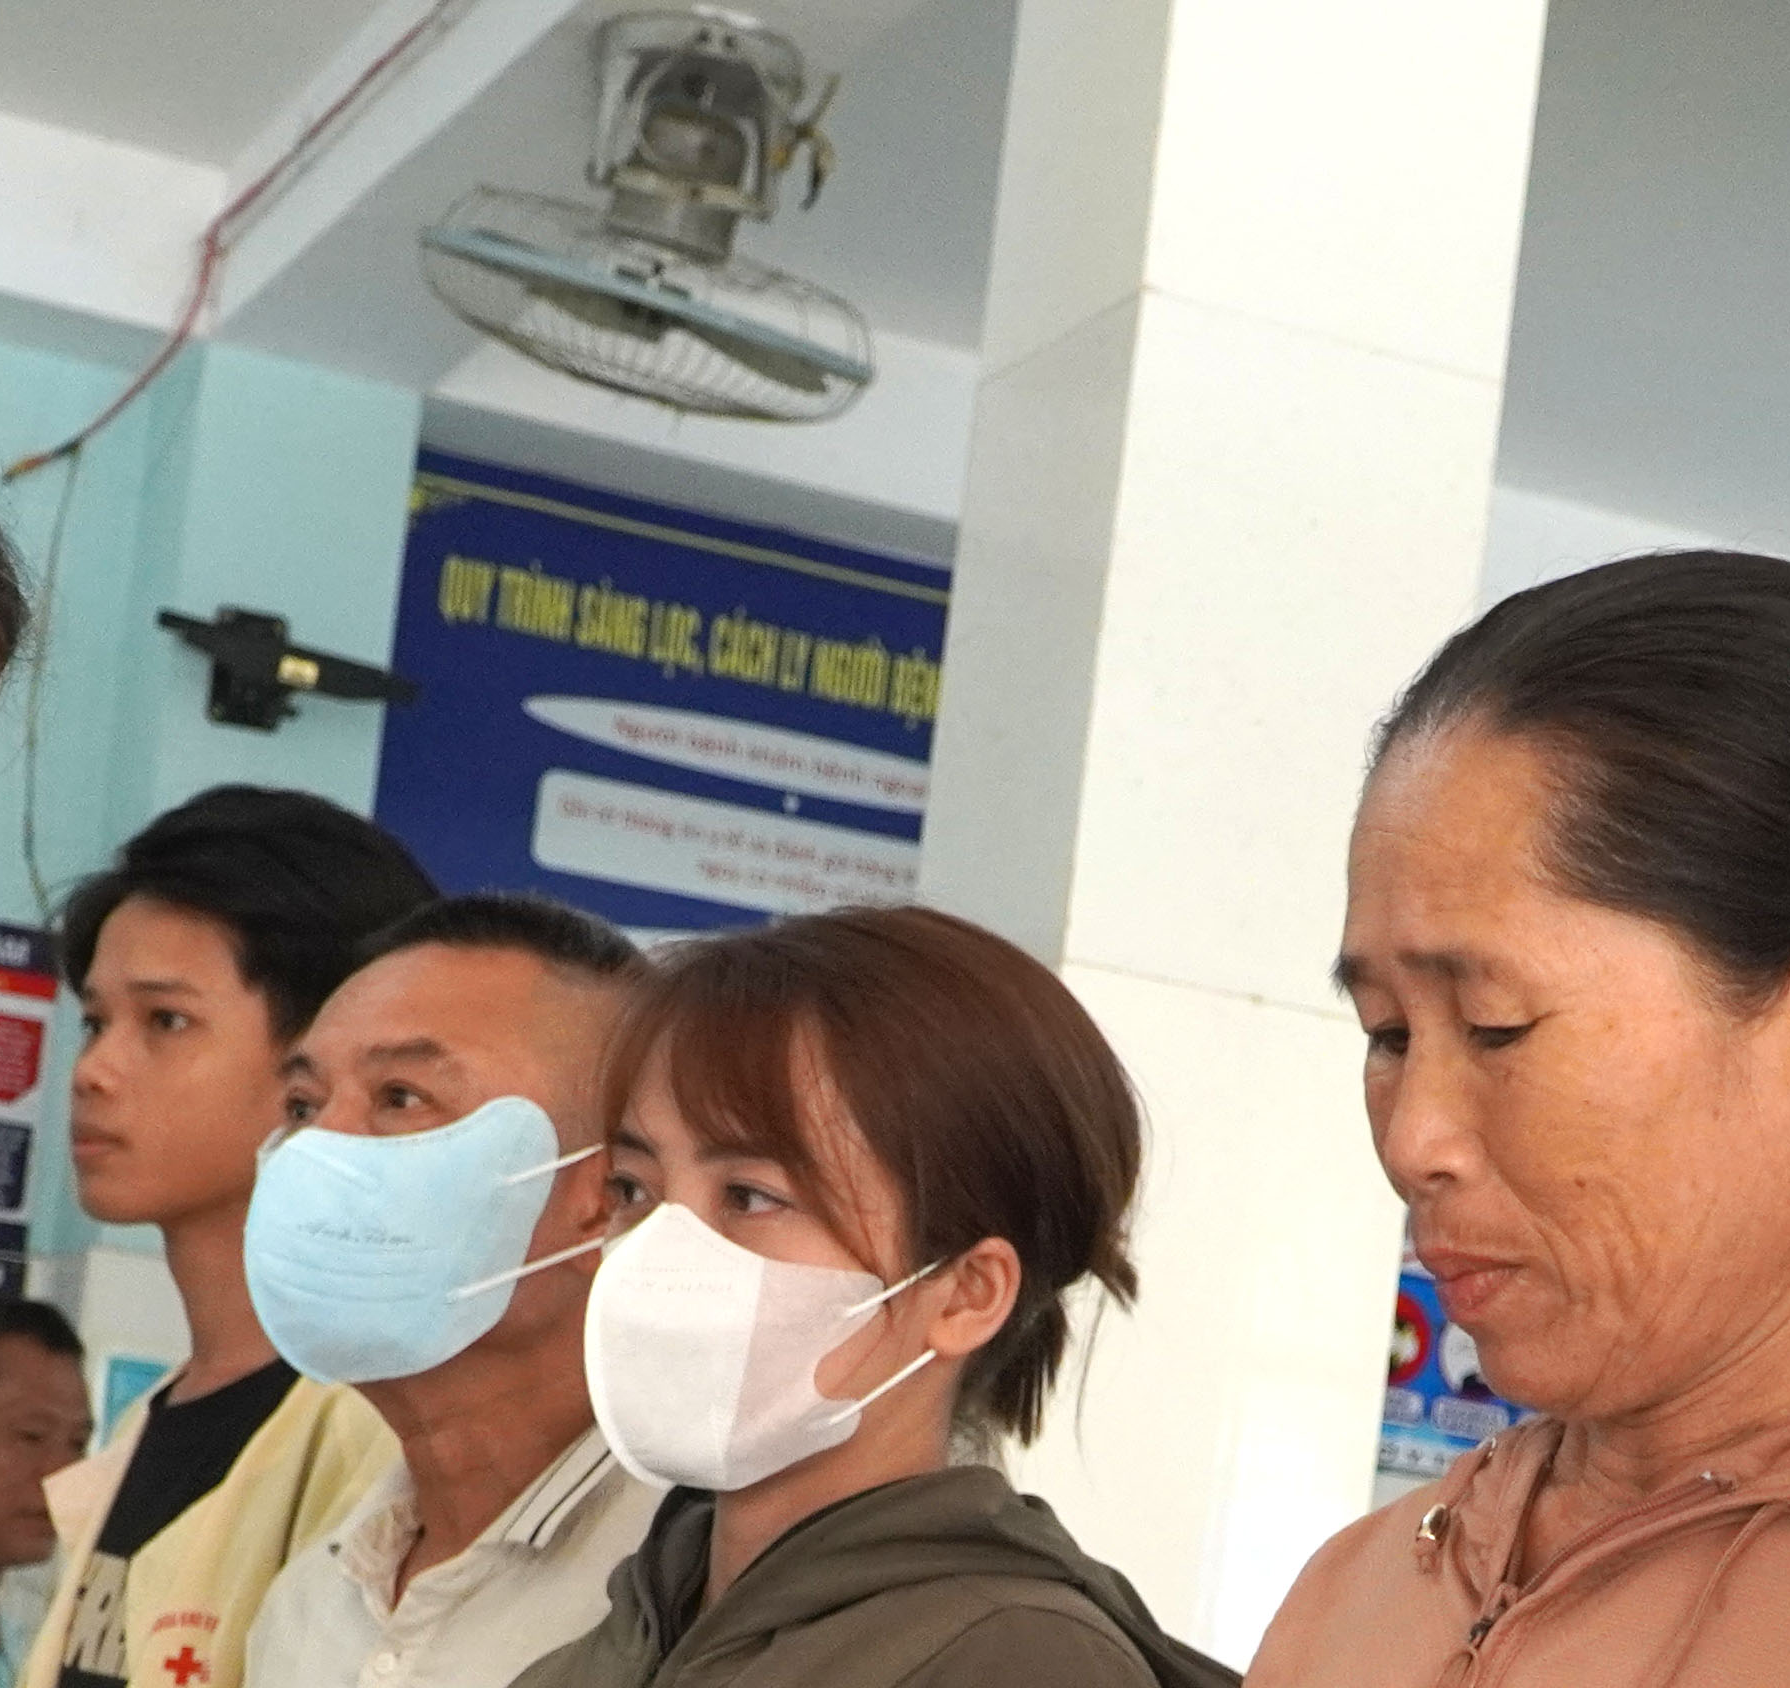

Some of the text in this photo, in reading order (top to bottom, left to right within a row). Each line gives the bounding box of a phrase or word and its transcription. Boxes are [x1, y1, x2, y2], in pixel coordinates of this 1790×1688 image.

[438, 554, 497, 627] QUY
[495, 558, 575, 645] TRÌNH
[709, 604, 778, 688] CÁCH
[777, 627, 811, 694] LY
